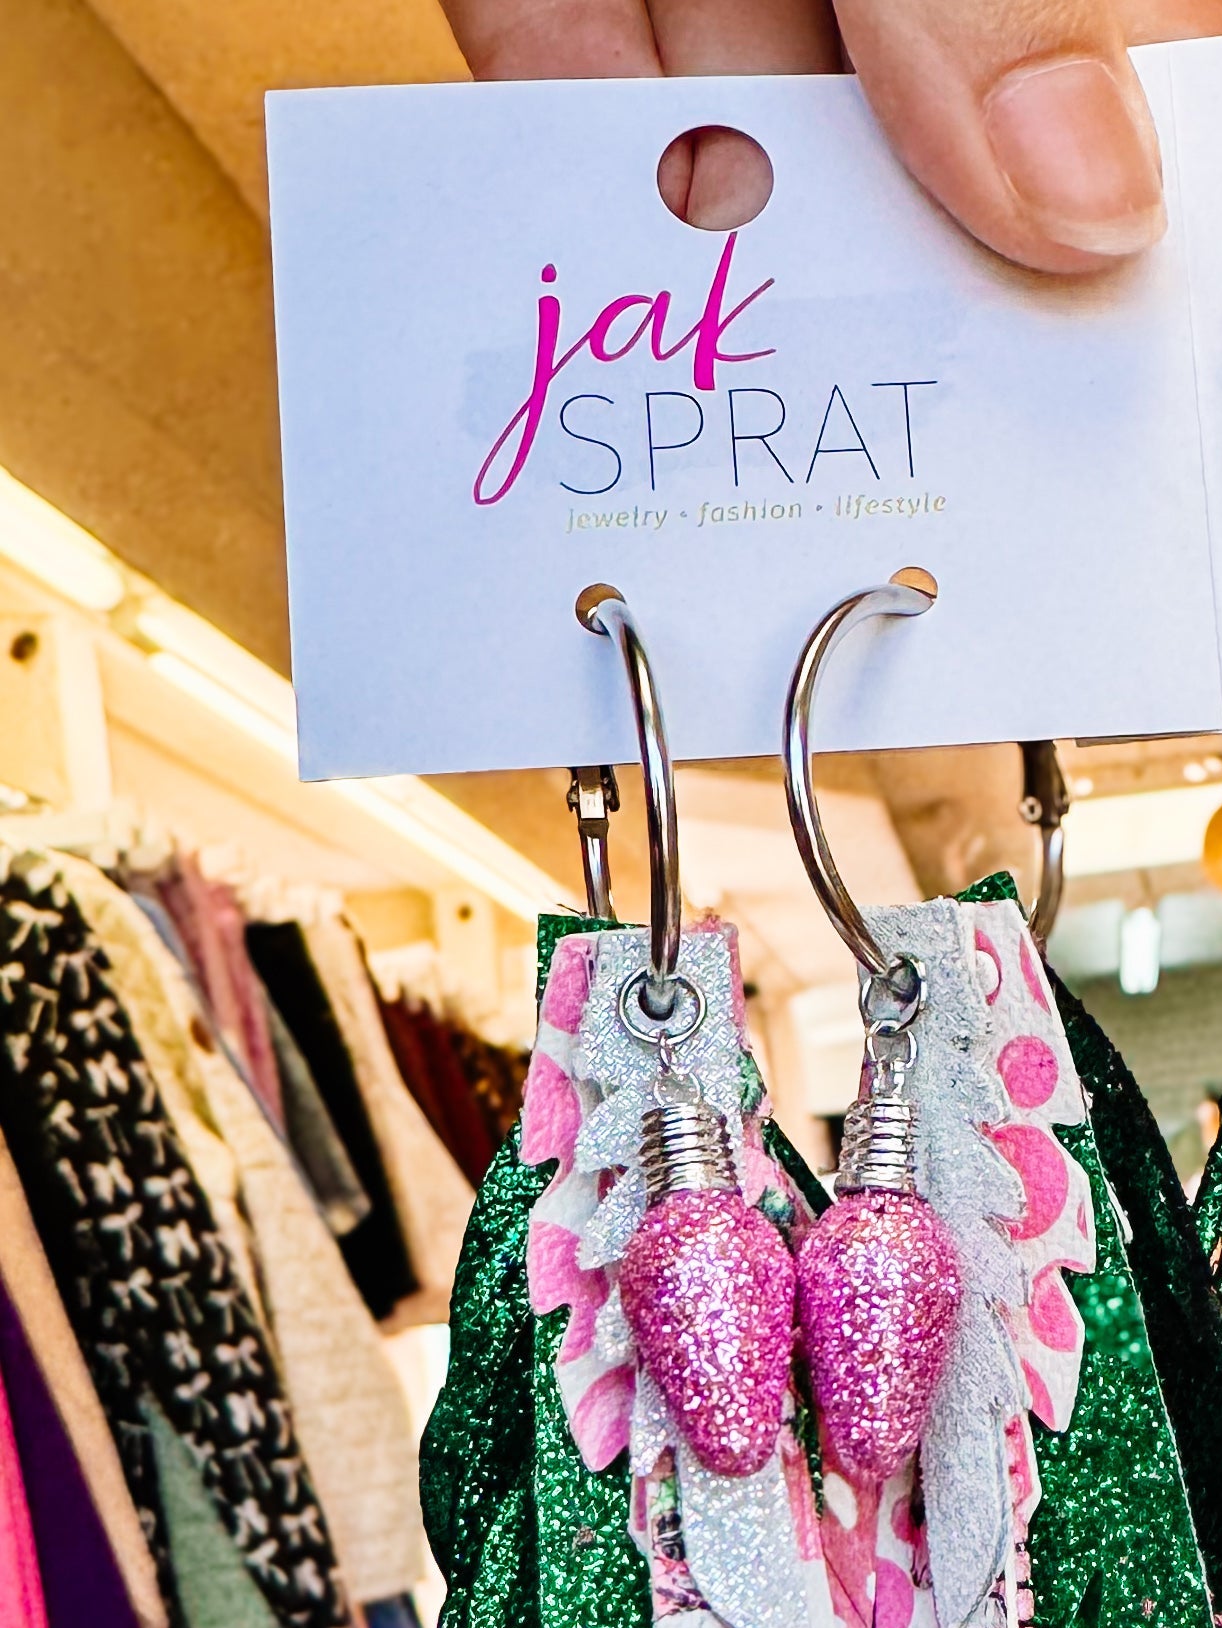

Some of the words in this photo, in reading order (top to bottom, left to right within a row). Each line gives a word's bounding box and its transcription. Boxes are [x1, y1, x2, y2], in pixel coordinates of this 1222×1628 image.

[473, 232, 775, 506] jak
[560, 380, 938, 495] SPRAT
[566, 506, 669, 534] jewelry
[698, 499, 802, 528] fashion
[834, 491, 948, 520] lifestyle
